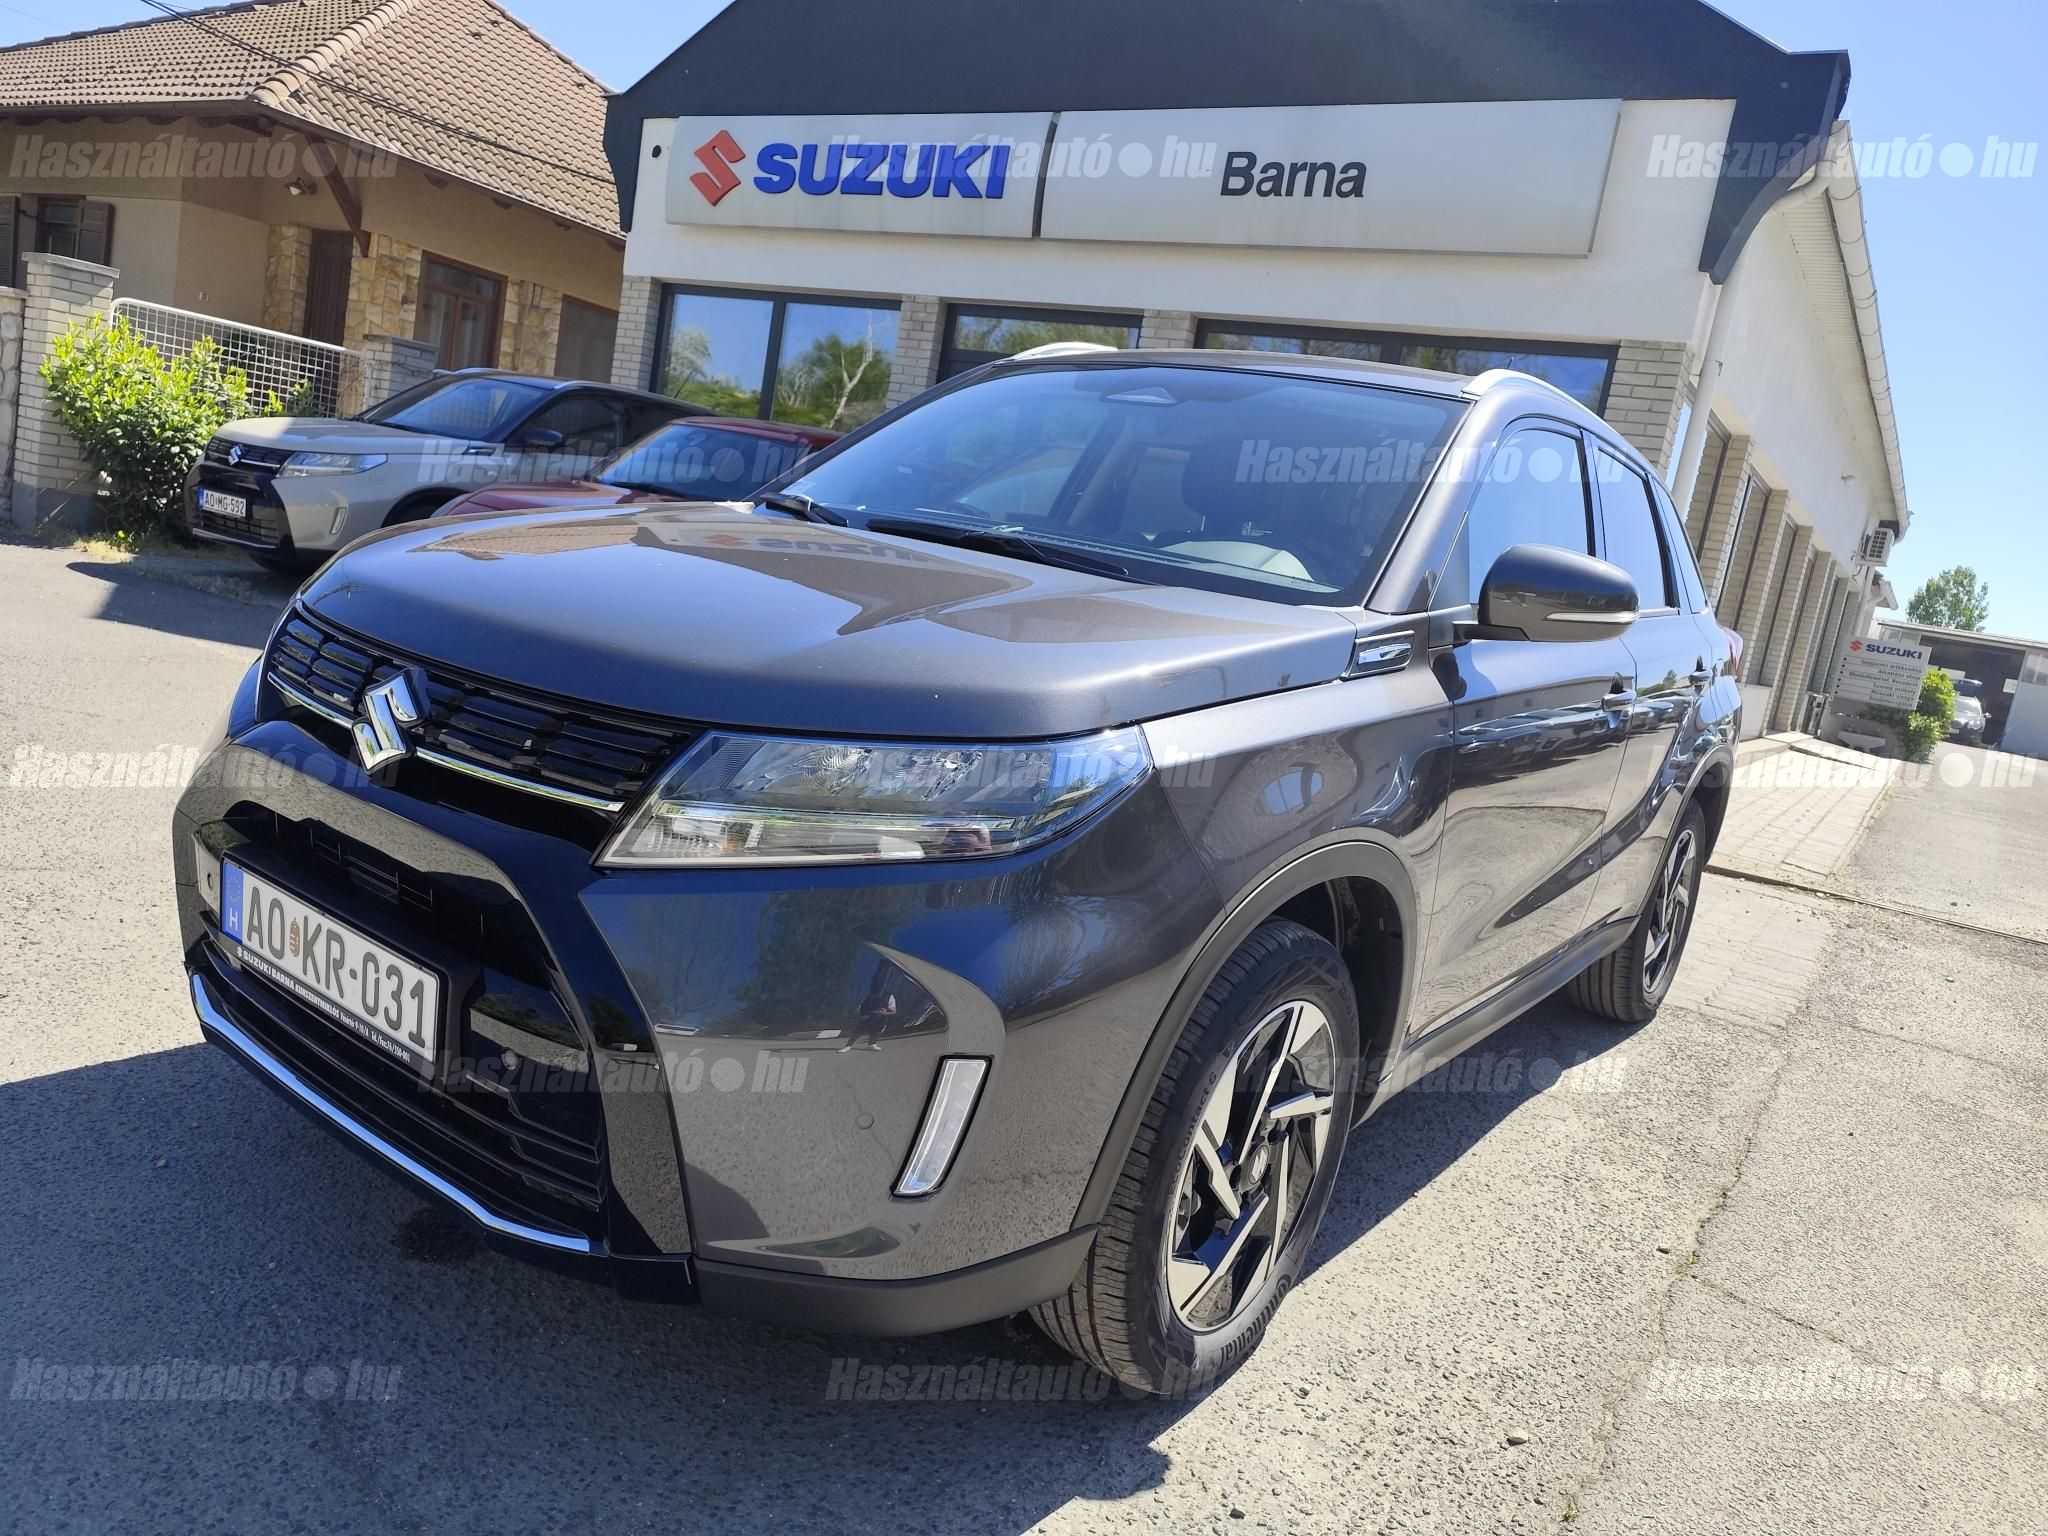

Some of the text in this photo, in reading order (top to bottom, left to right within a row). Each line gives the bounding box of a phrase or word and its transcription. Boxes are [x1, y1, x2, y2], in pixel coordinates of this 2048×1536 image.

[753, 142, 1011, 200] SUZUKI
[1220, 151, 1367, 198] Barna
[1865, 643, 1922, 660] SUZUKI
[229, 907, 239, 931] H
[243, 950, 271, 975] SUZUKI
[271, 968, 295, 990] BARNA
[247, 886, 426, 1048] AO KR-031
